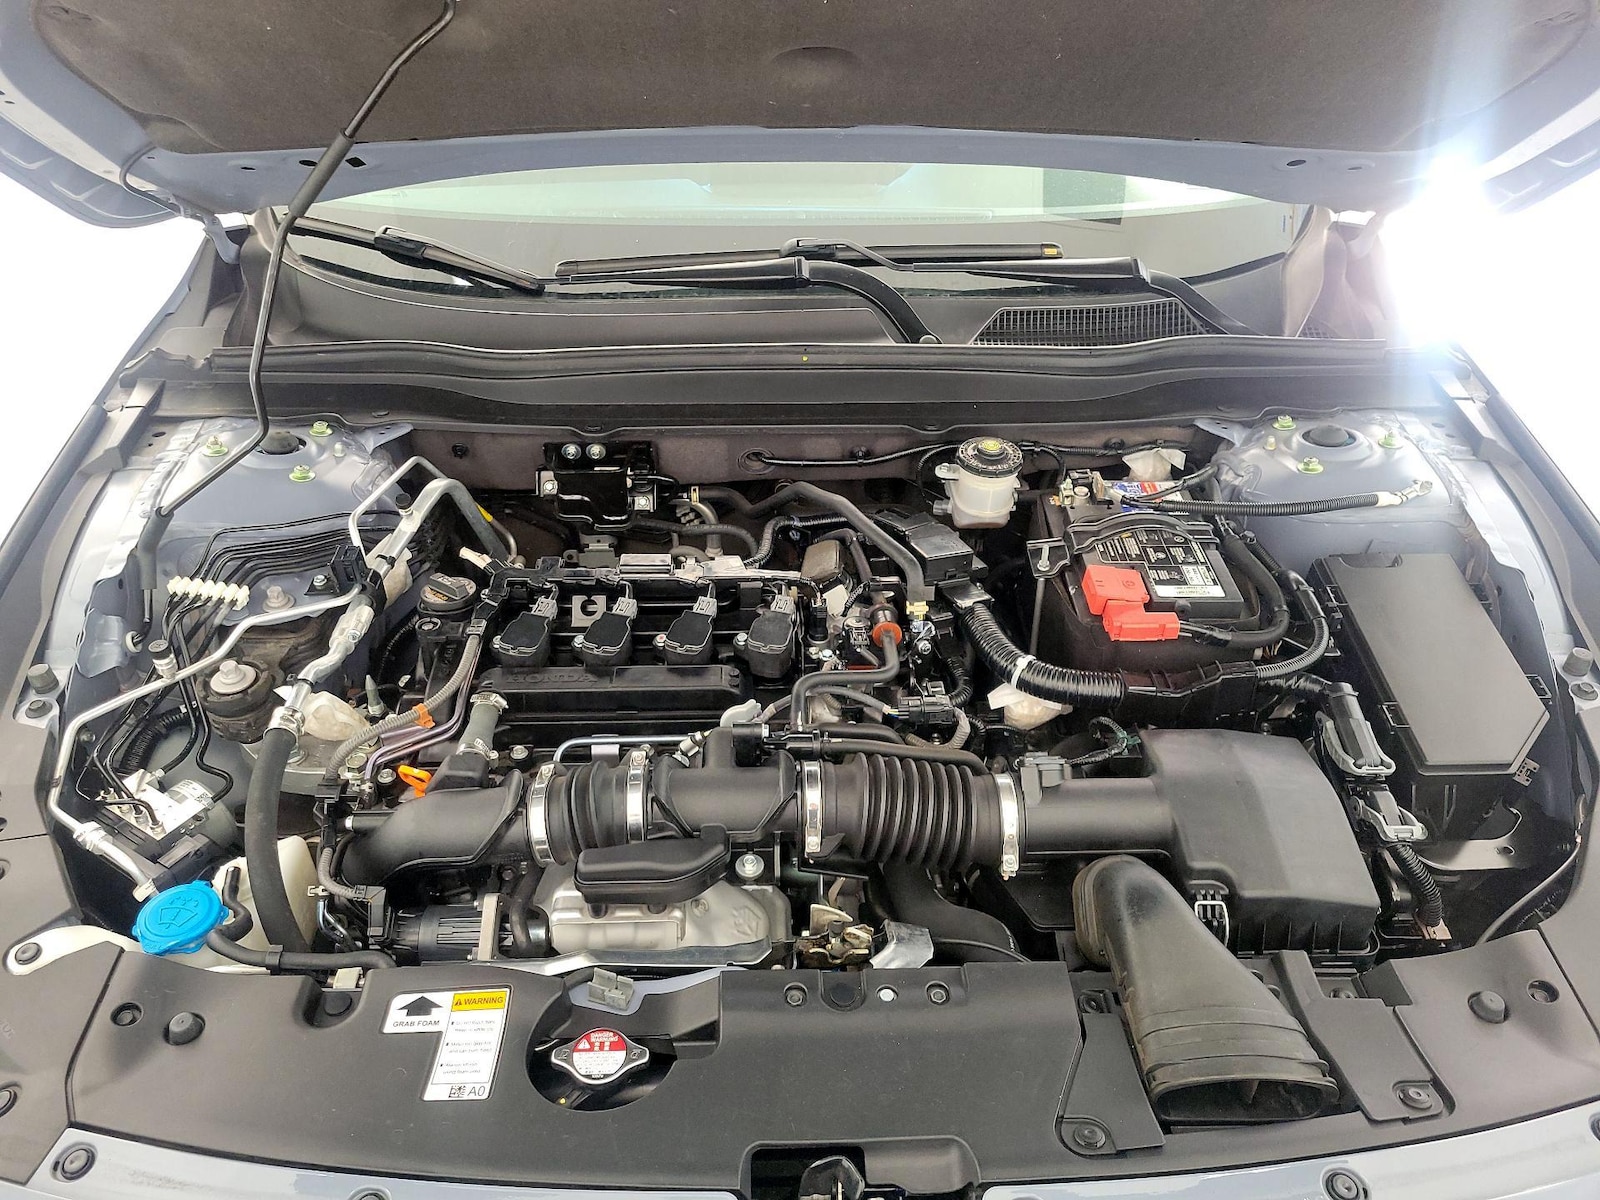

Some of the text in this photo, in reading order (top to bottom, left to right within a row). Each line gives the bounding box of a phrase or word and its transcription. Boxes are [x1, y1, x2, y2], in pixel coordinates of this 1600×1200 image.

[506, 673, 598, 684] HONDA
[464, 997, 504, 1006] WARNING
[417, 1020, 440, 1028] FOAM
